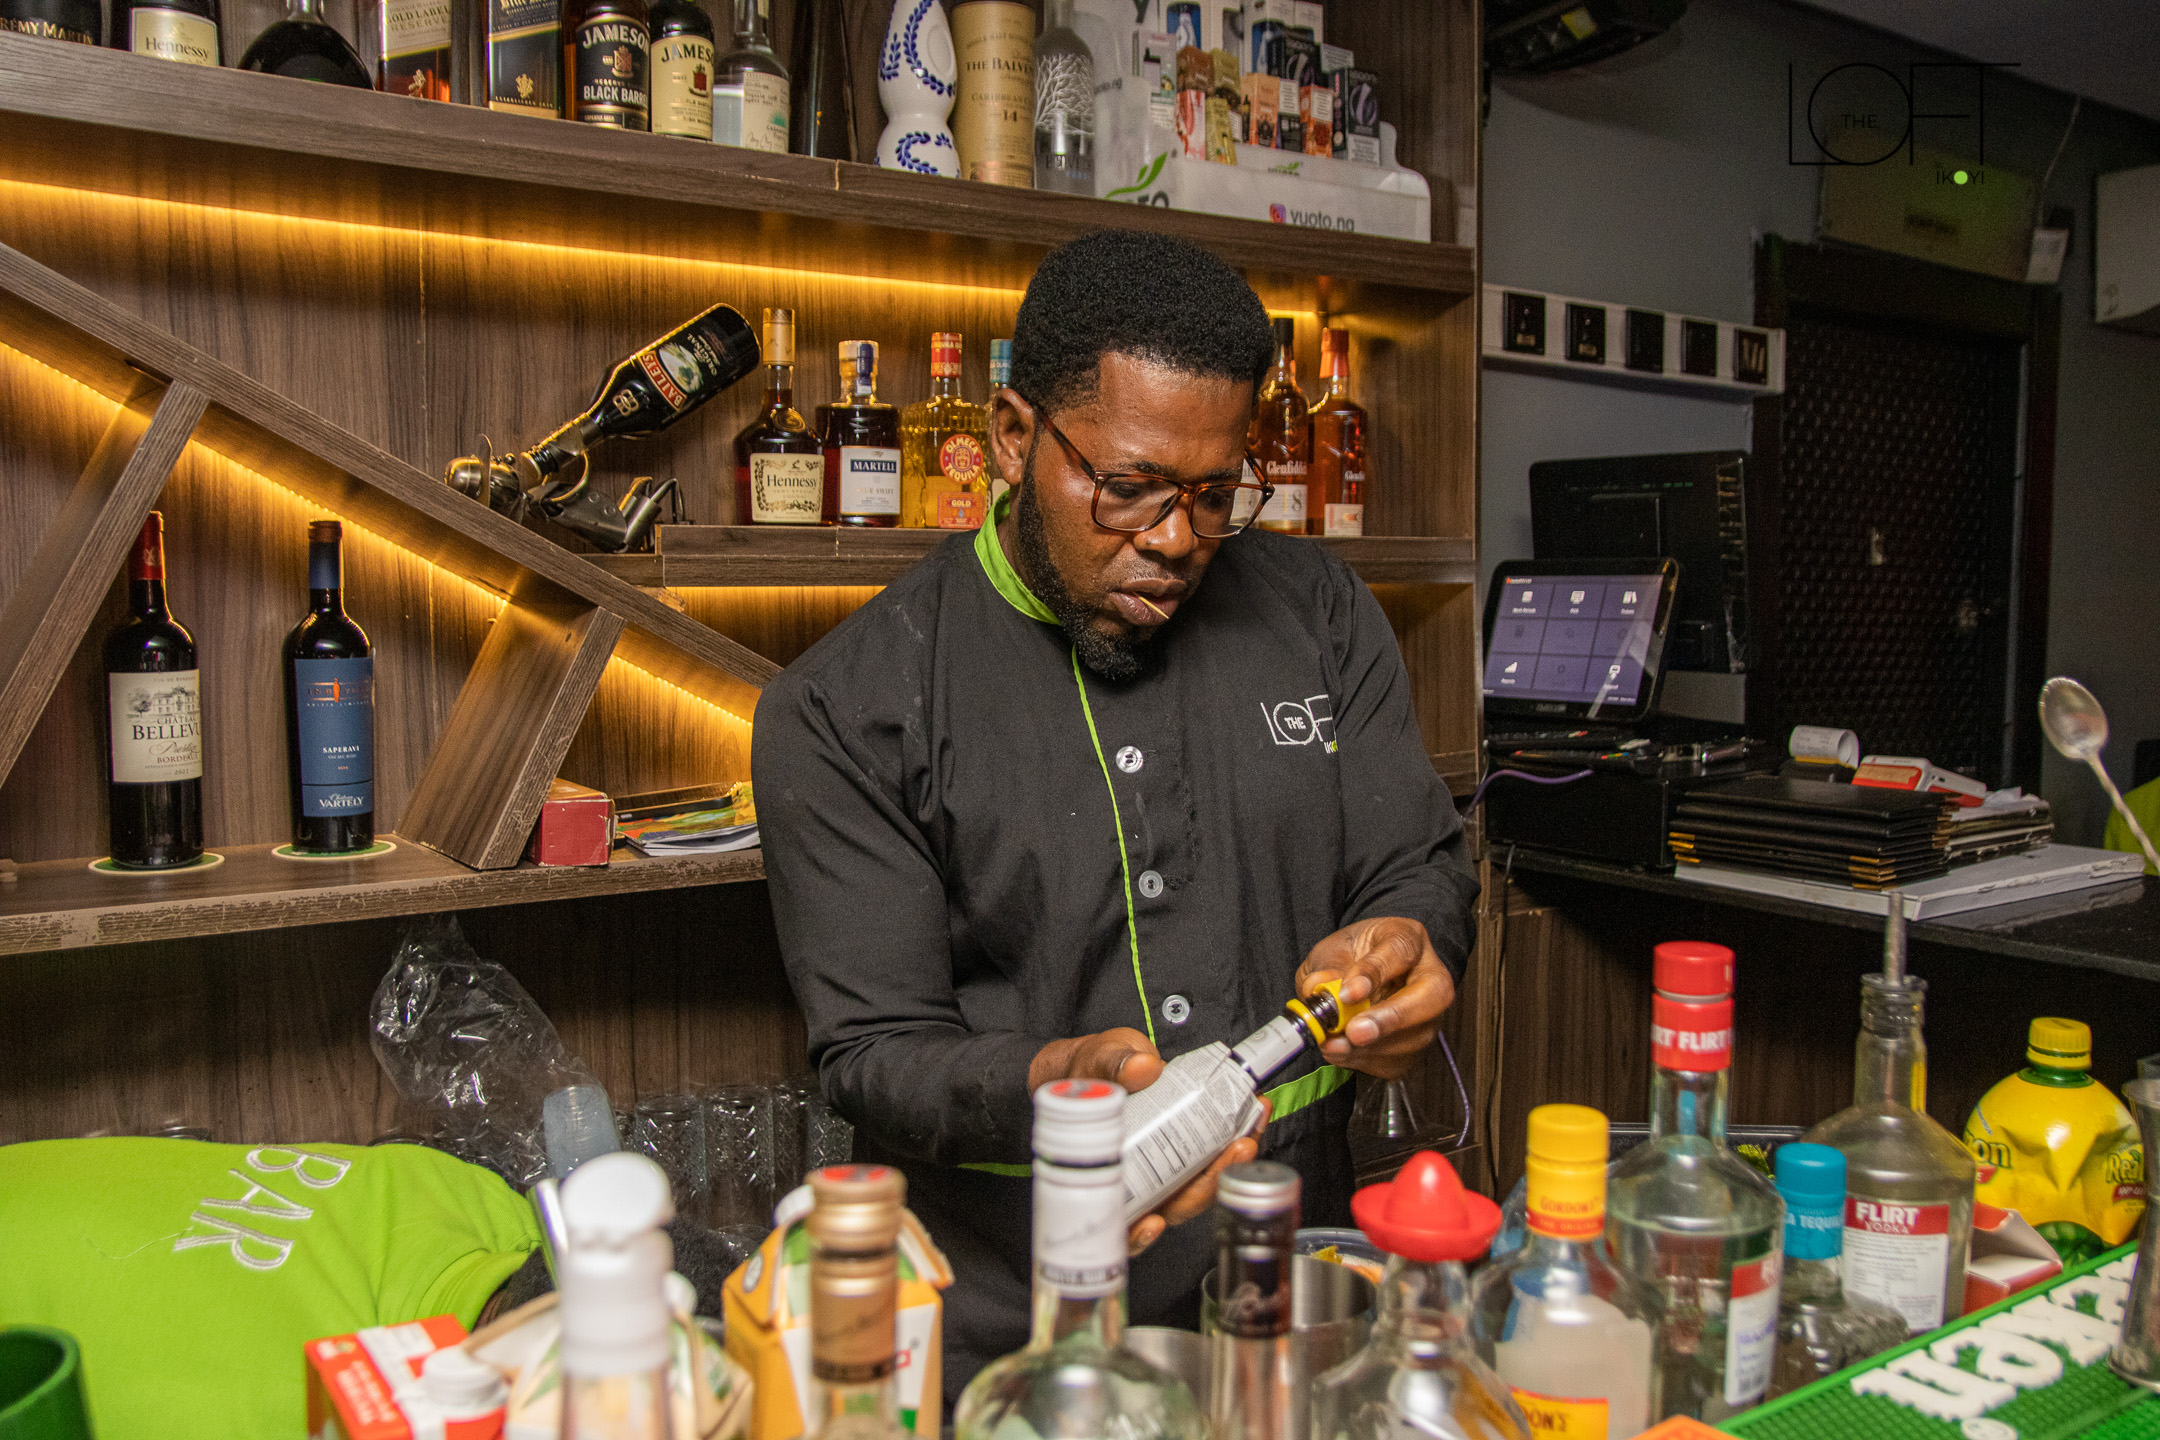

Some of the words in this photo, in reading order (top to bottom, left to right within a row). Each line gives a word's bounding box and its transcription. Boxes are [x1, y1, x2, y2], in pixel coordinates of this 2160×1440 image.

[145, 37, 209, 59] Hennessy
[661, 43, 713, 63] JAMES
[584, 86, 619, 101] BLACK
[642, 354, 683, 407] BAILEYS
[945, 437, 980, 454] OLMECA
[853, 461, 895, 472] MARTELL
[945, 462, 980, 481] TEQUILA
[767, 474, 817, 490] Hennessy
[951, 500, 972, 508] GOLD
[1284, 716, 1307, 730] THE
[322, 745, 360, 754] SAPERAVI
[319, 796, 364, 808] VARTELY
[1678, 1031, 1726, 1053] FLIRT
[173, 1145, 353, 1270] BAR
[1855, 1201, 1920, 1226] FLIRT
[1865, 1220, 1910, 1234] VODKA
